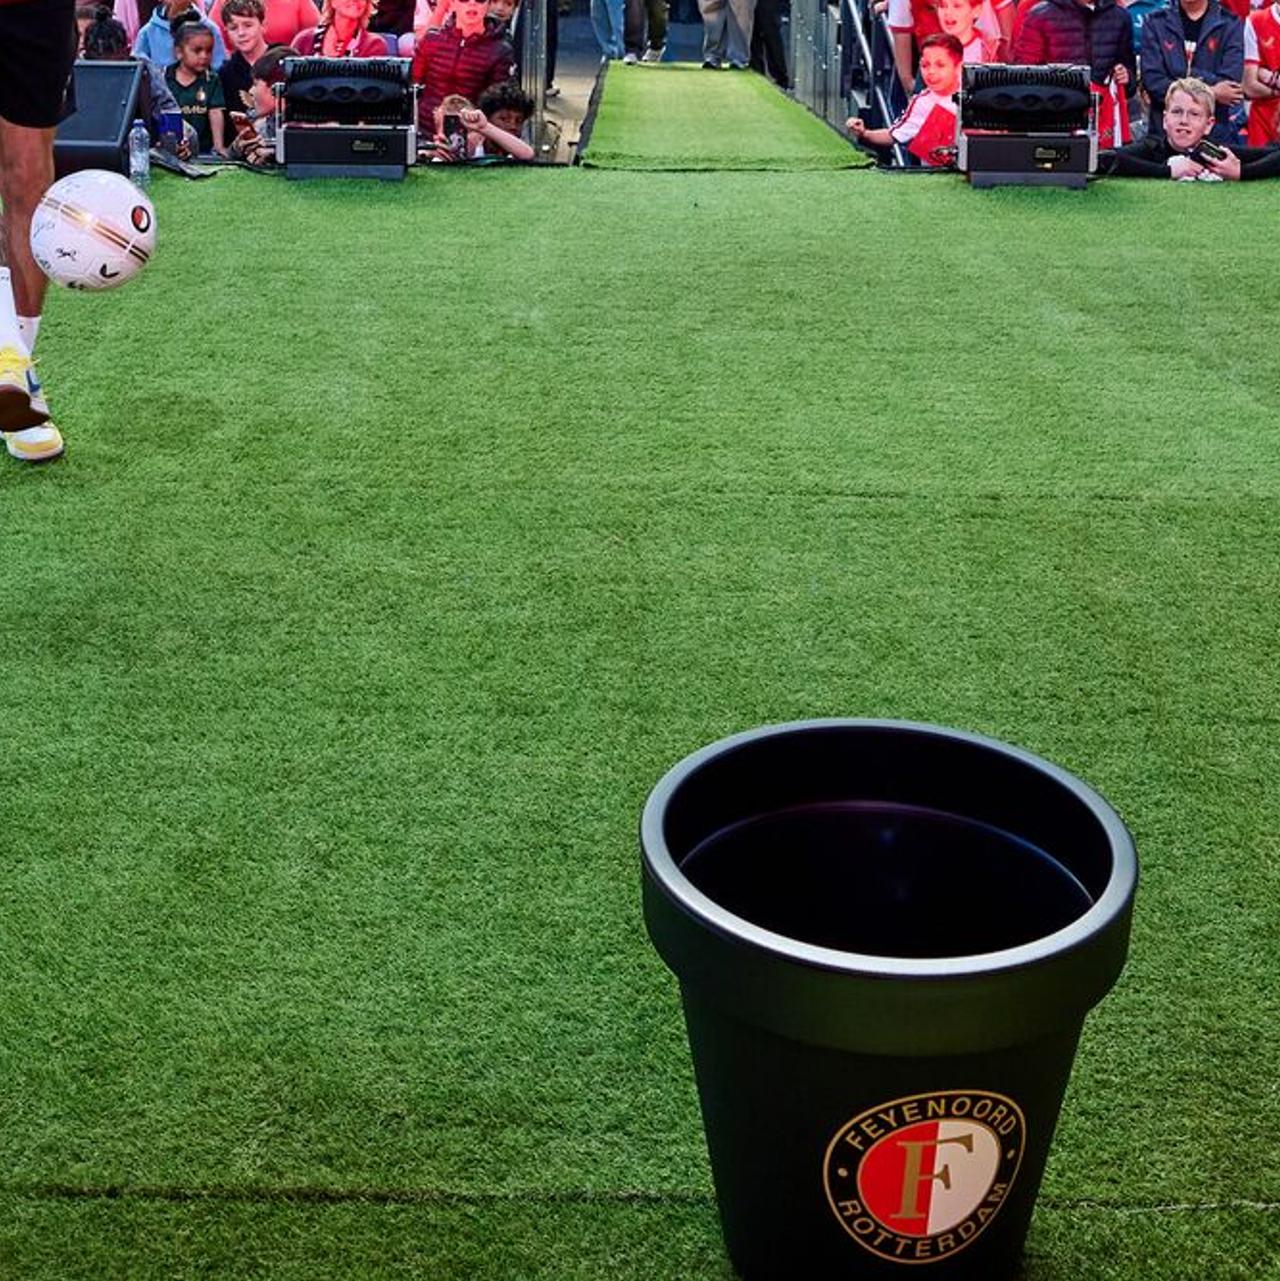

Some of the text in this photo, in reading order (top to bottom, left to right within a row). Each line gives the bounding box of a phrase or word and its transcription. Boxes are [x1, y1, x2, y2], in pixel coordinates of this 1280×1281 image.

[845, 1096, 1017, 1151] FEYENOORD
[889, 1132, 974, 1220] F
[837, 1182, 1008, 1258] ROTTERDAM
